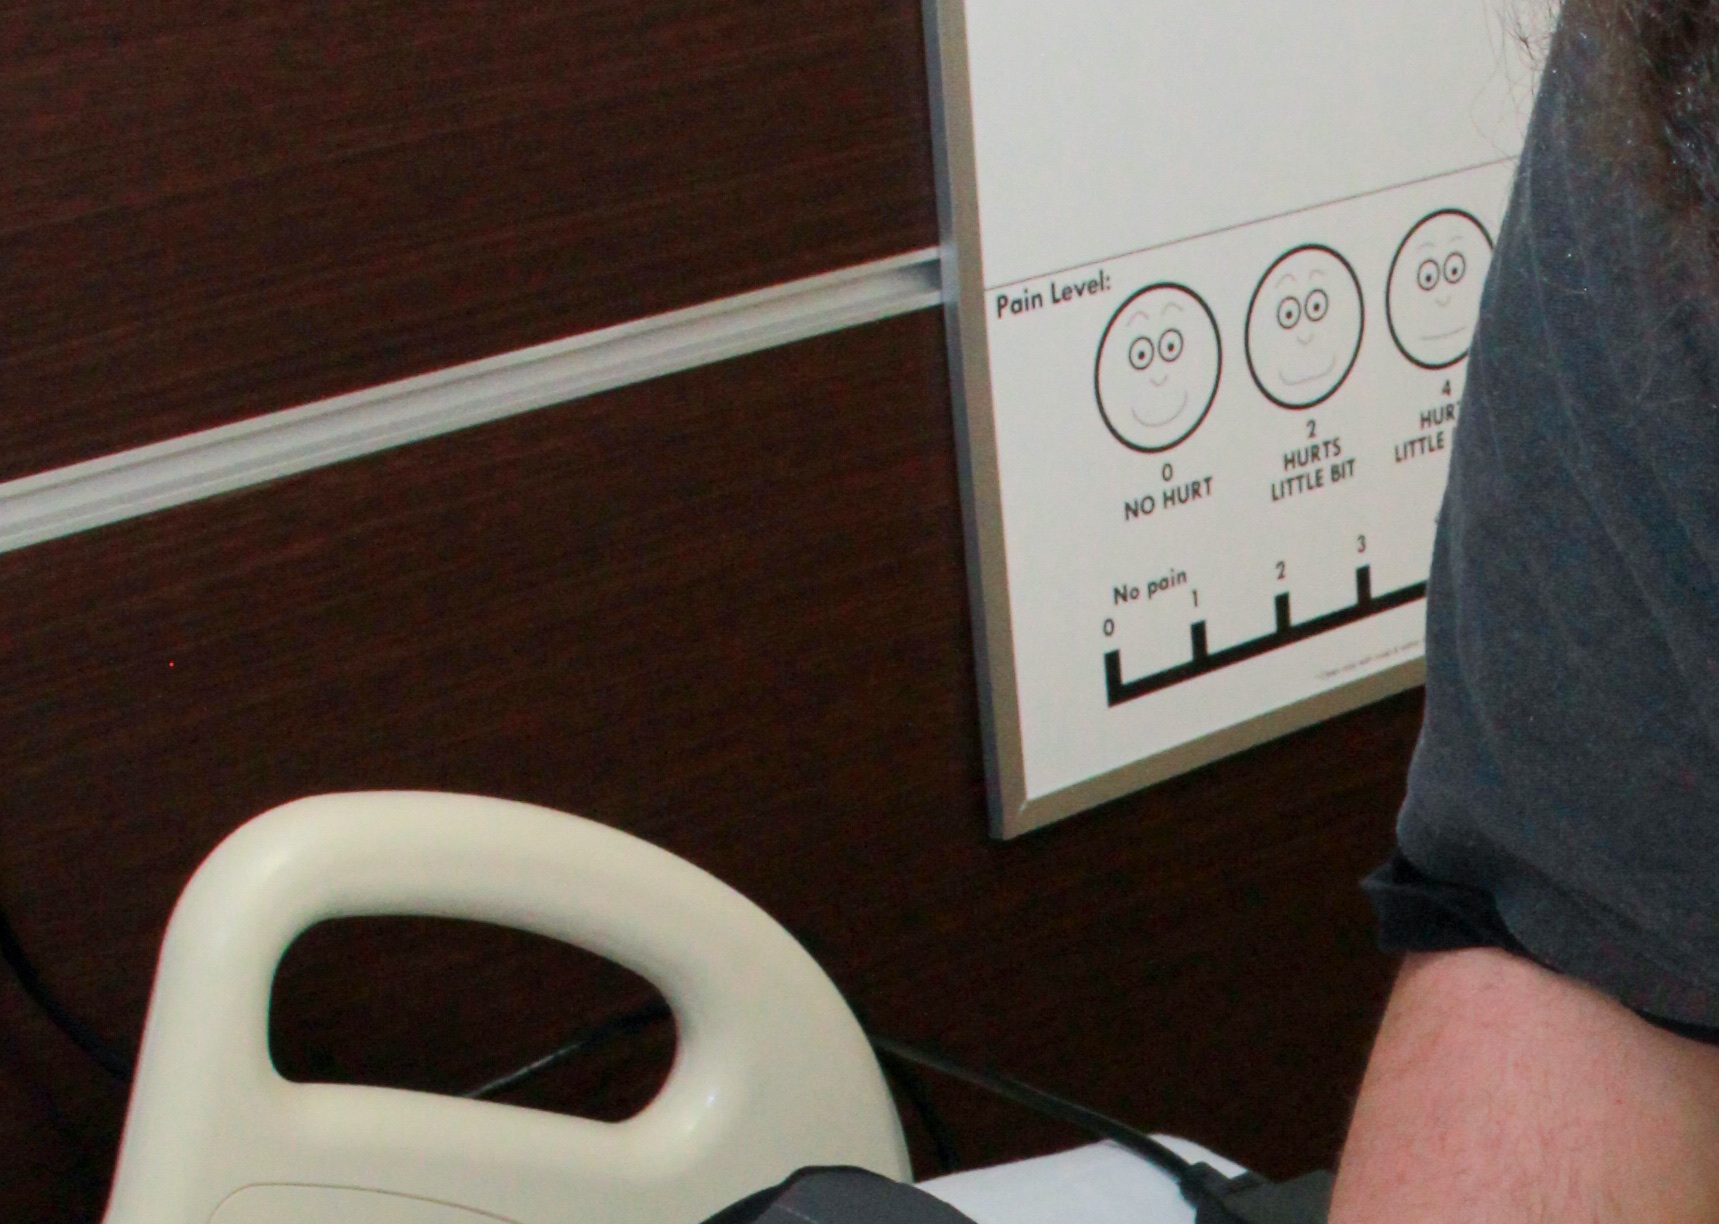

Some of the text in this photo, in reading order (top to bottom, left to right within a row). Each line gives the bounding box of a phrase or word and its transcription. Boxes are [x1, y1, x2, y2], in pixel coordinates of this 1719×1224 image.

[997, 269, 1110, 320] Pain Level:
[1442, 379, 1451, 396] 4
[1306, 418, 1317, 439] 2
[1420, 401, 1461, 429] HUR
[1283, 436, 1341, 471] HURTS
[1394, 431, 1444, 463] LITTLE
[1161, 462, 1173, 482] 0
[1271, 458, 1356, 502] LITTLE BIT
[1124, 476, 1213, 521] NO HURT
[1103, 534, 1366, 637] 0 1 2 3
[1113, 568, 1187, 606] No pain
